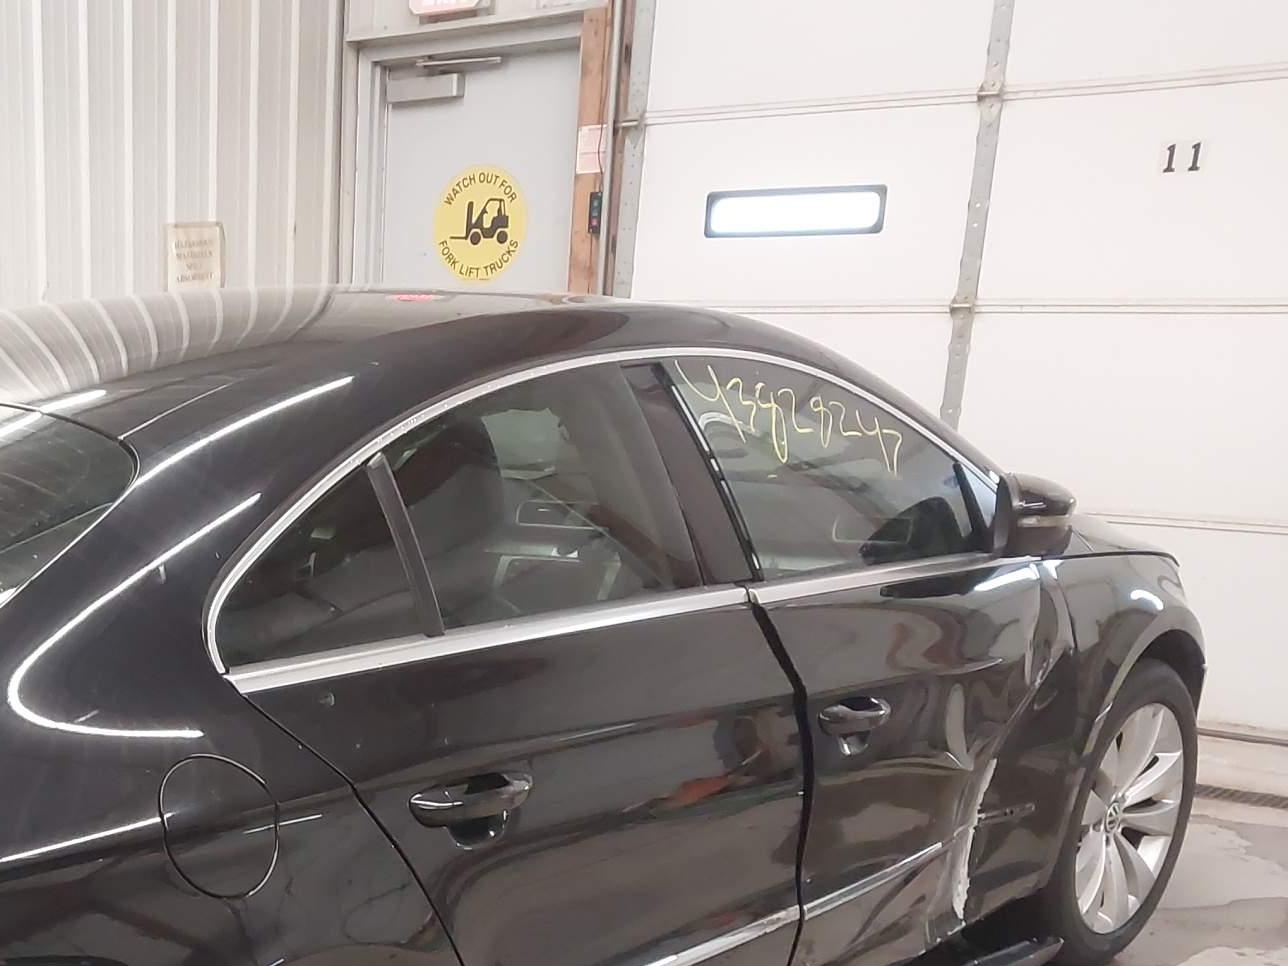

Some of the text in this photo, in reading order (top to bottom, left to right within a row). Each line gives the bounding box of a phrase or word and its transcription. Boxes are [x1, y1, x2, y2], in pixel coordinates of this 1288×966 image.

[1162, 142, 1201, 173] 11
[443, 172, 517, 206] WATCH OUT FOR
[439, 239, 519, 278] FORK LIFT TRUCKS
